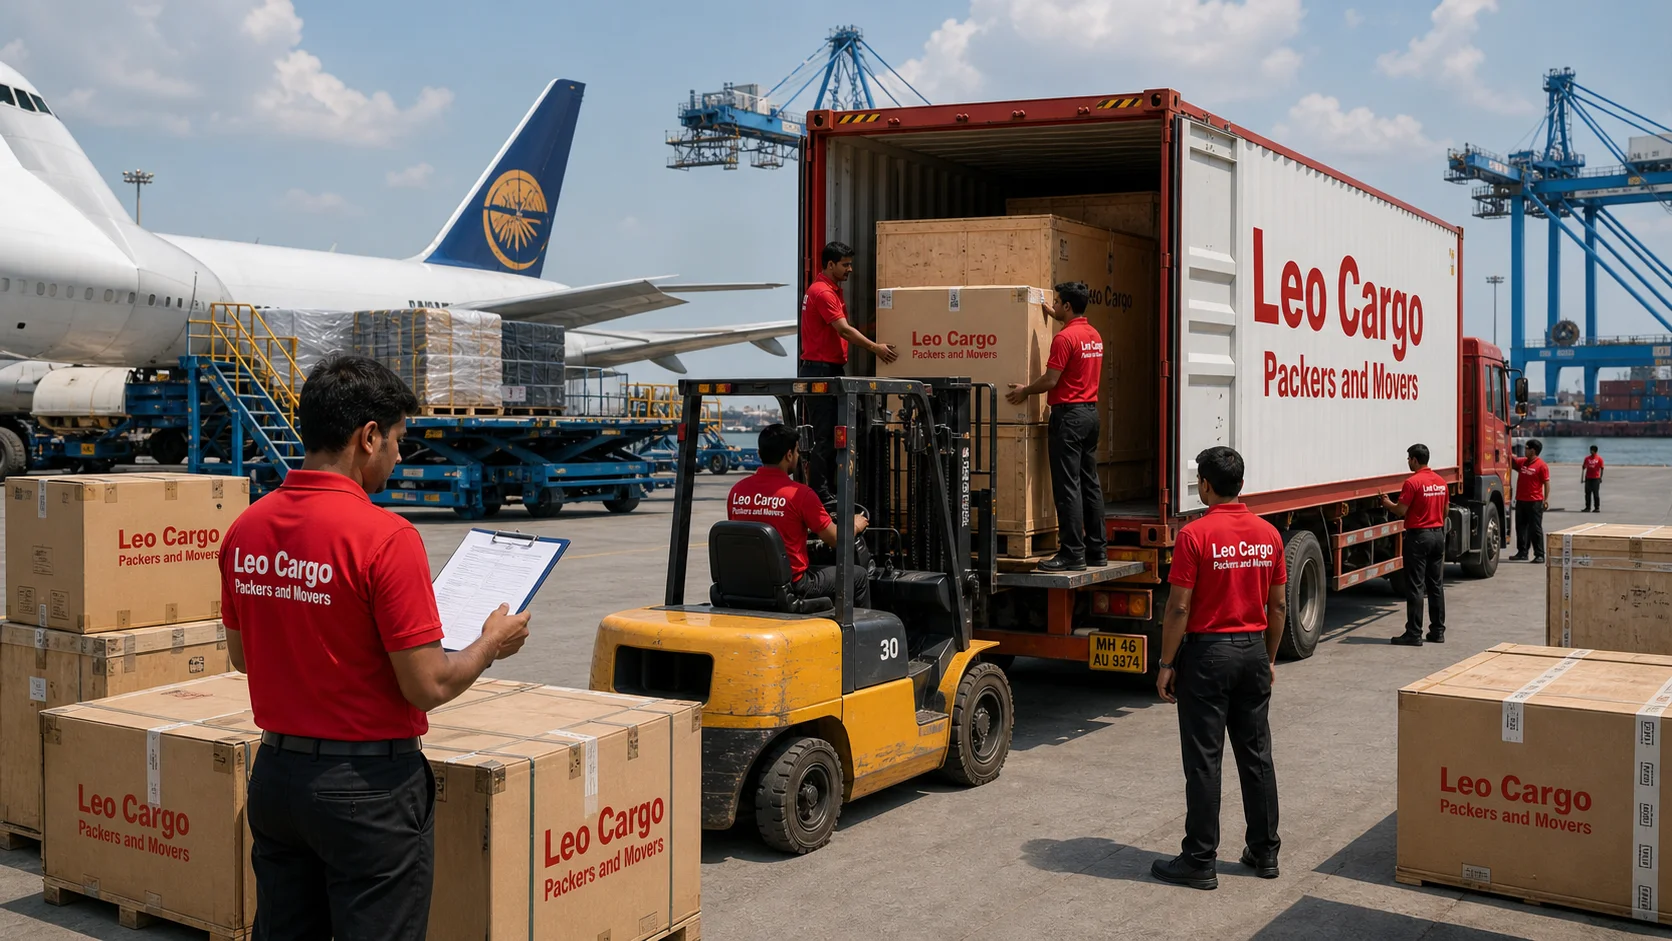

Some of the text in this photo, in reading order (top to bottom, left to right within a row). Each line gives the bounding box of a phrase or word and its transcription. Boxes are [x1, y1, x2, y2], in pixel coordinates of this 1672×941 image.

[1104, 285, 1133, 313] Cargo
[1253, 227, 1423, 362] Leo Cargo
[911, 330, 997, 349] Leo Cargo
[912, 350, 997, 359] Packers and Movers
[1264, 351, 1419, 401] Packers and Movers
[732, 492, 787, 510] Leo Cargo
[119, 526, 220, 549] Leo Cargo
[1212, 541, 1274, 559] Leo Cargo
[119, 550, 219, 567] Packers and Movers
[234, 547, 333, 588] Leo Cargo
[235, 578, 332, 605] Packers and Movers
[880, 637, 899, 661] 30
[1096, 636, 1137, 653] MH 46
[1093, 653, 1140, 669] AU 9374
[1440, 766, 1593, 815] Leo Cargo
[78, 783, 190, 840] Leo Cargo
[1440, 799, 1593, 835] Packers and Movers
[79, 819, 190, 862] Packers and Movers
[545, 797, 664, 868] Leo Cargo
[544, 837, 664, 902] Packers and Movers
